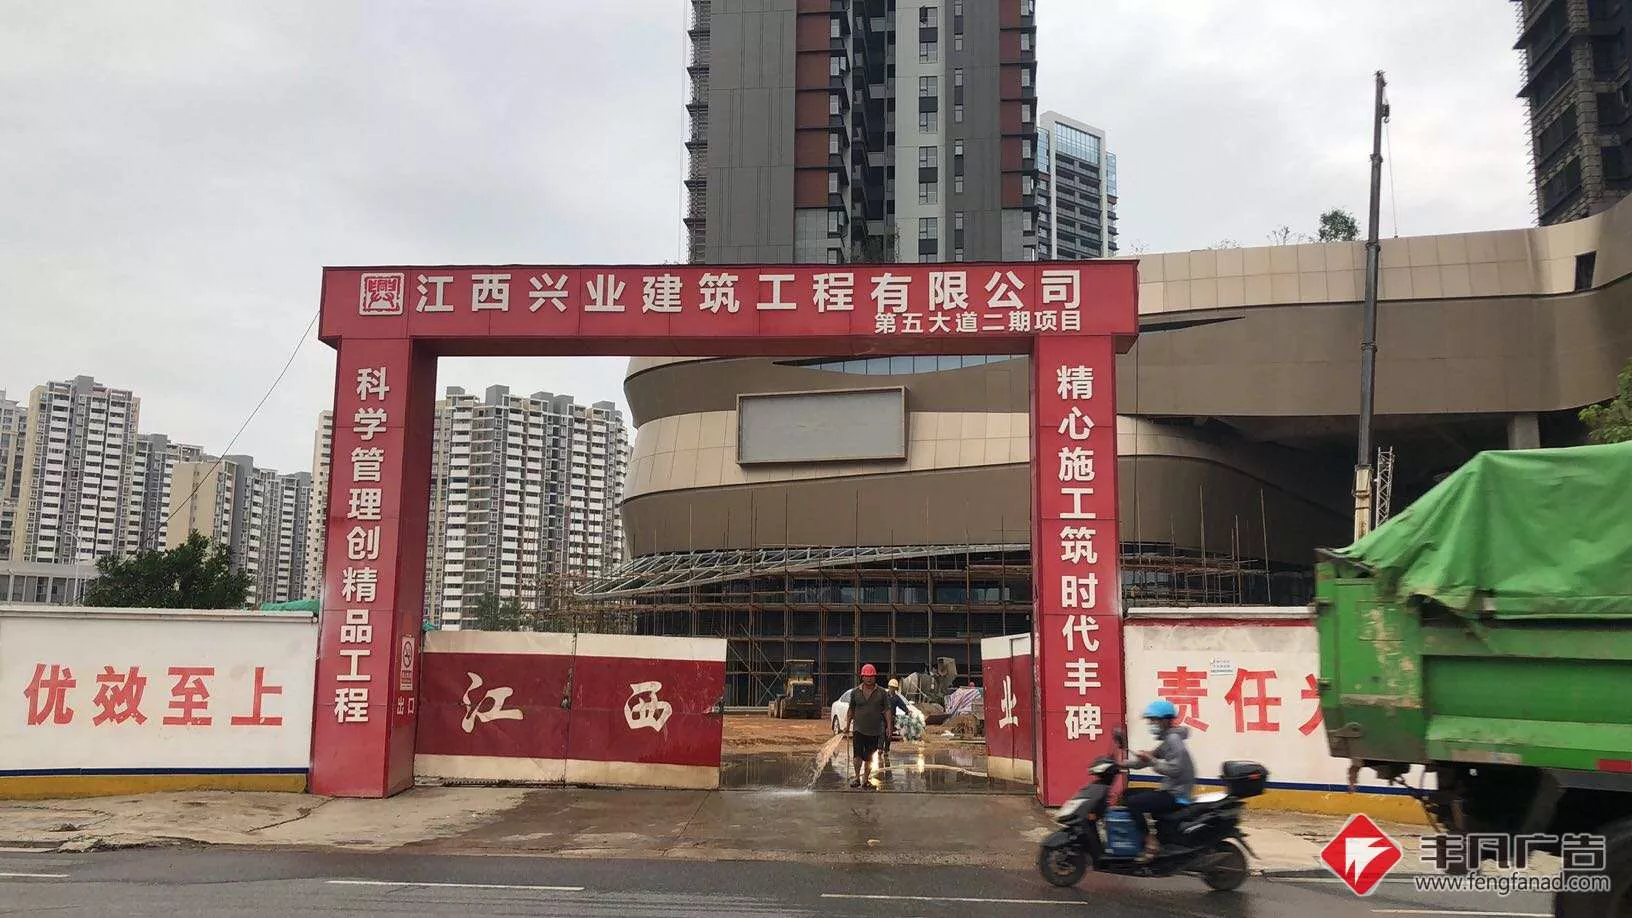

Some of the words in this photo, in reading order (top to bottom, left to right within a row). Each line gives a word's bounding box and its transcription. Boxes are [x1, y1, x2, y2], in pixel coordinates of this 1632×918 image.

[416, 270, 1081, 314] 江西兴业建筑工程有限公司
[874, 311, 1081, 334] 第五大道二期项目
[334, 366, 390, 724] 科学管理创精品工程
[1057, 365, 1103, 741] 精心施工筑时代丰碑
[23, 663, 283, 726] 优效至上
